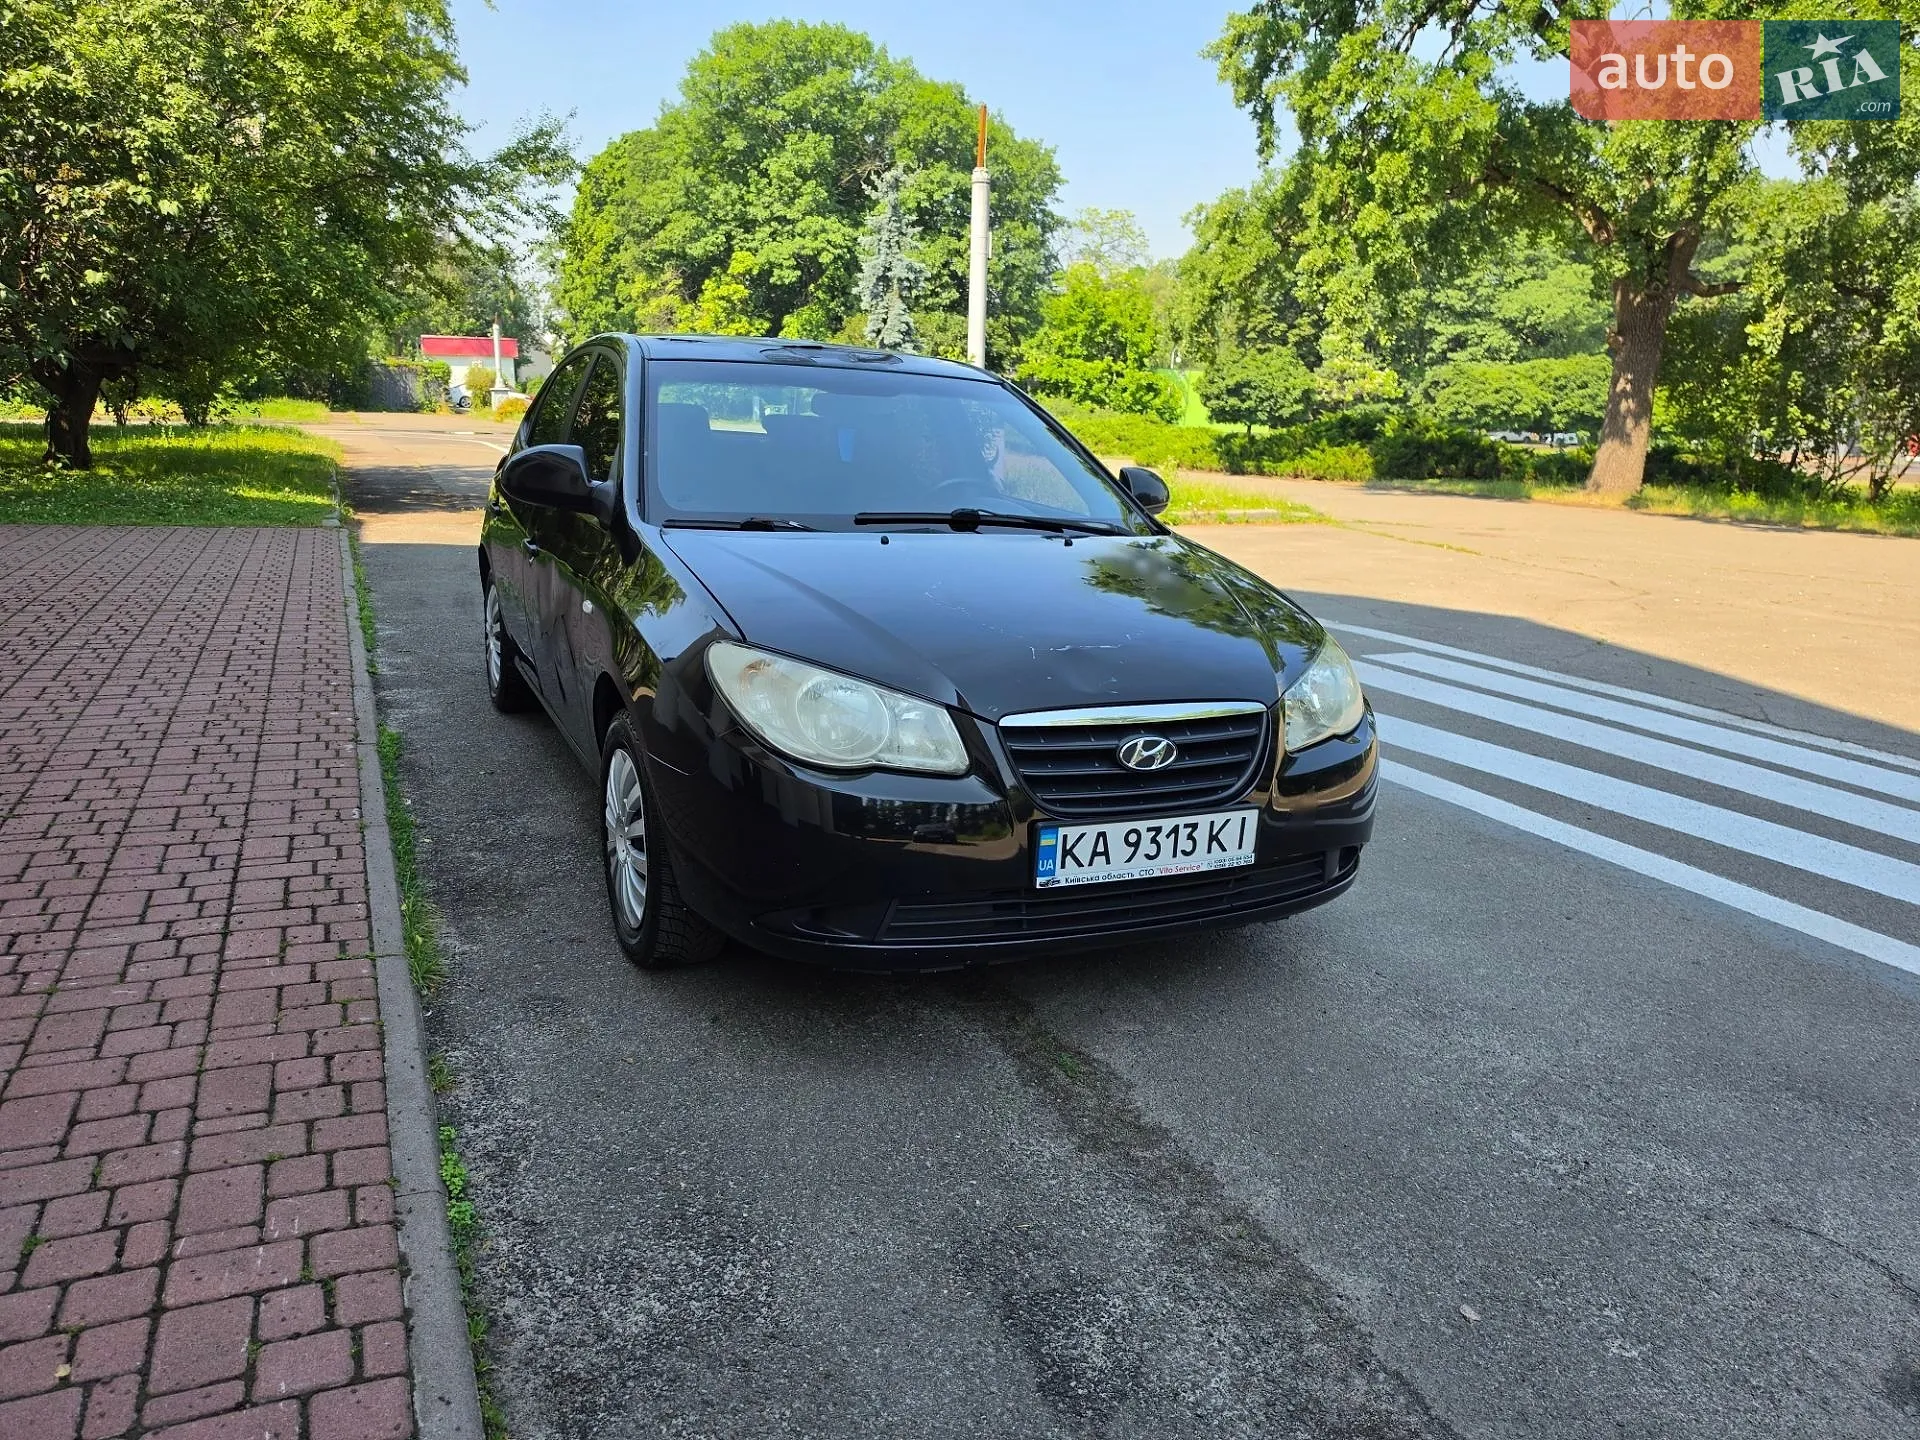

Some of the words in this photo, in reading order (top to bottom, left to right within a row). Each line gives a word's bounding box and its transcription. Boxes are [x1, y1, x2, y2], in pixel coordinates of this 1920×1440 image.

[1060, 831, 1111, 870] KA
[1123, 821, 1199, 864] 9313
[1038, 859, 1054, 872] UA
[1064, 875, 1100, 885] Київська
[1101, 871, 1135, 881] область
